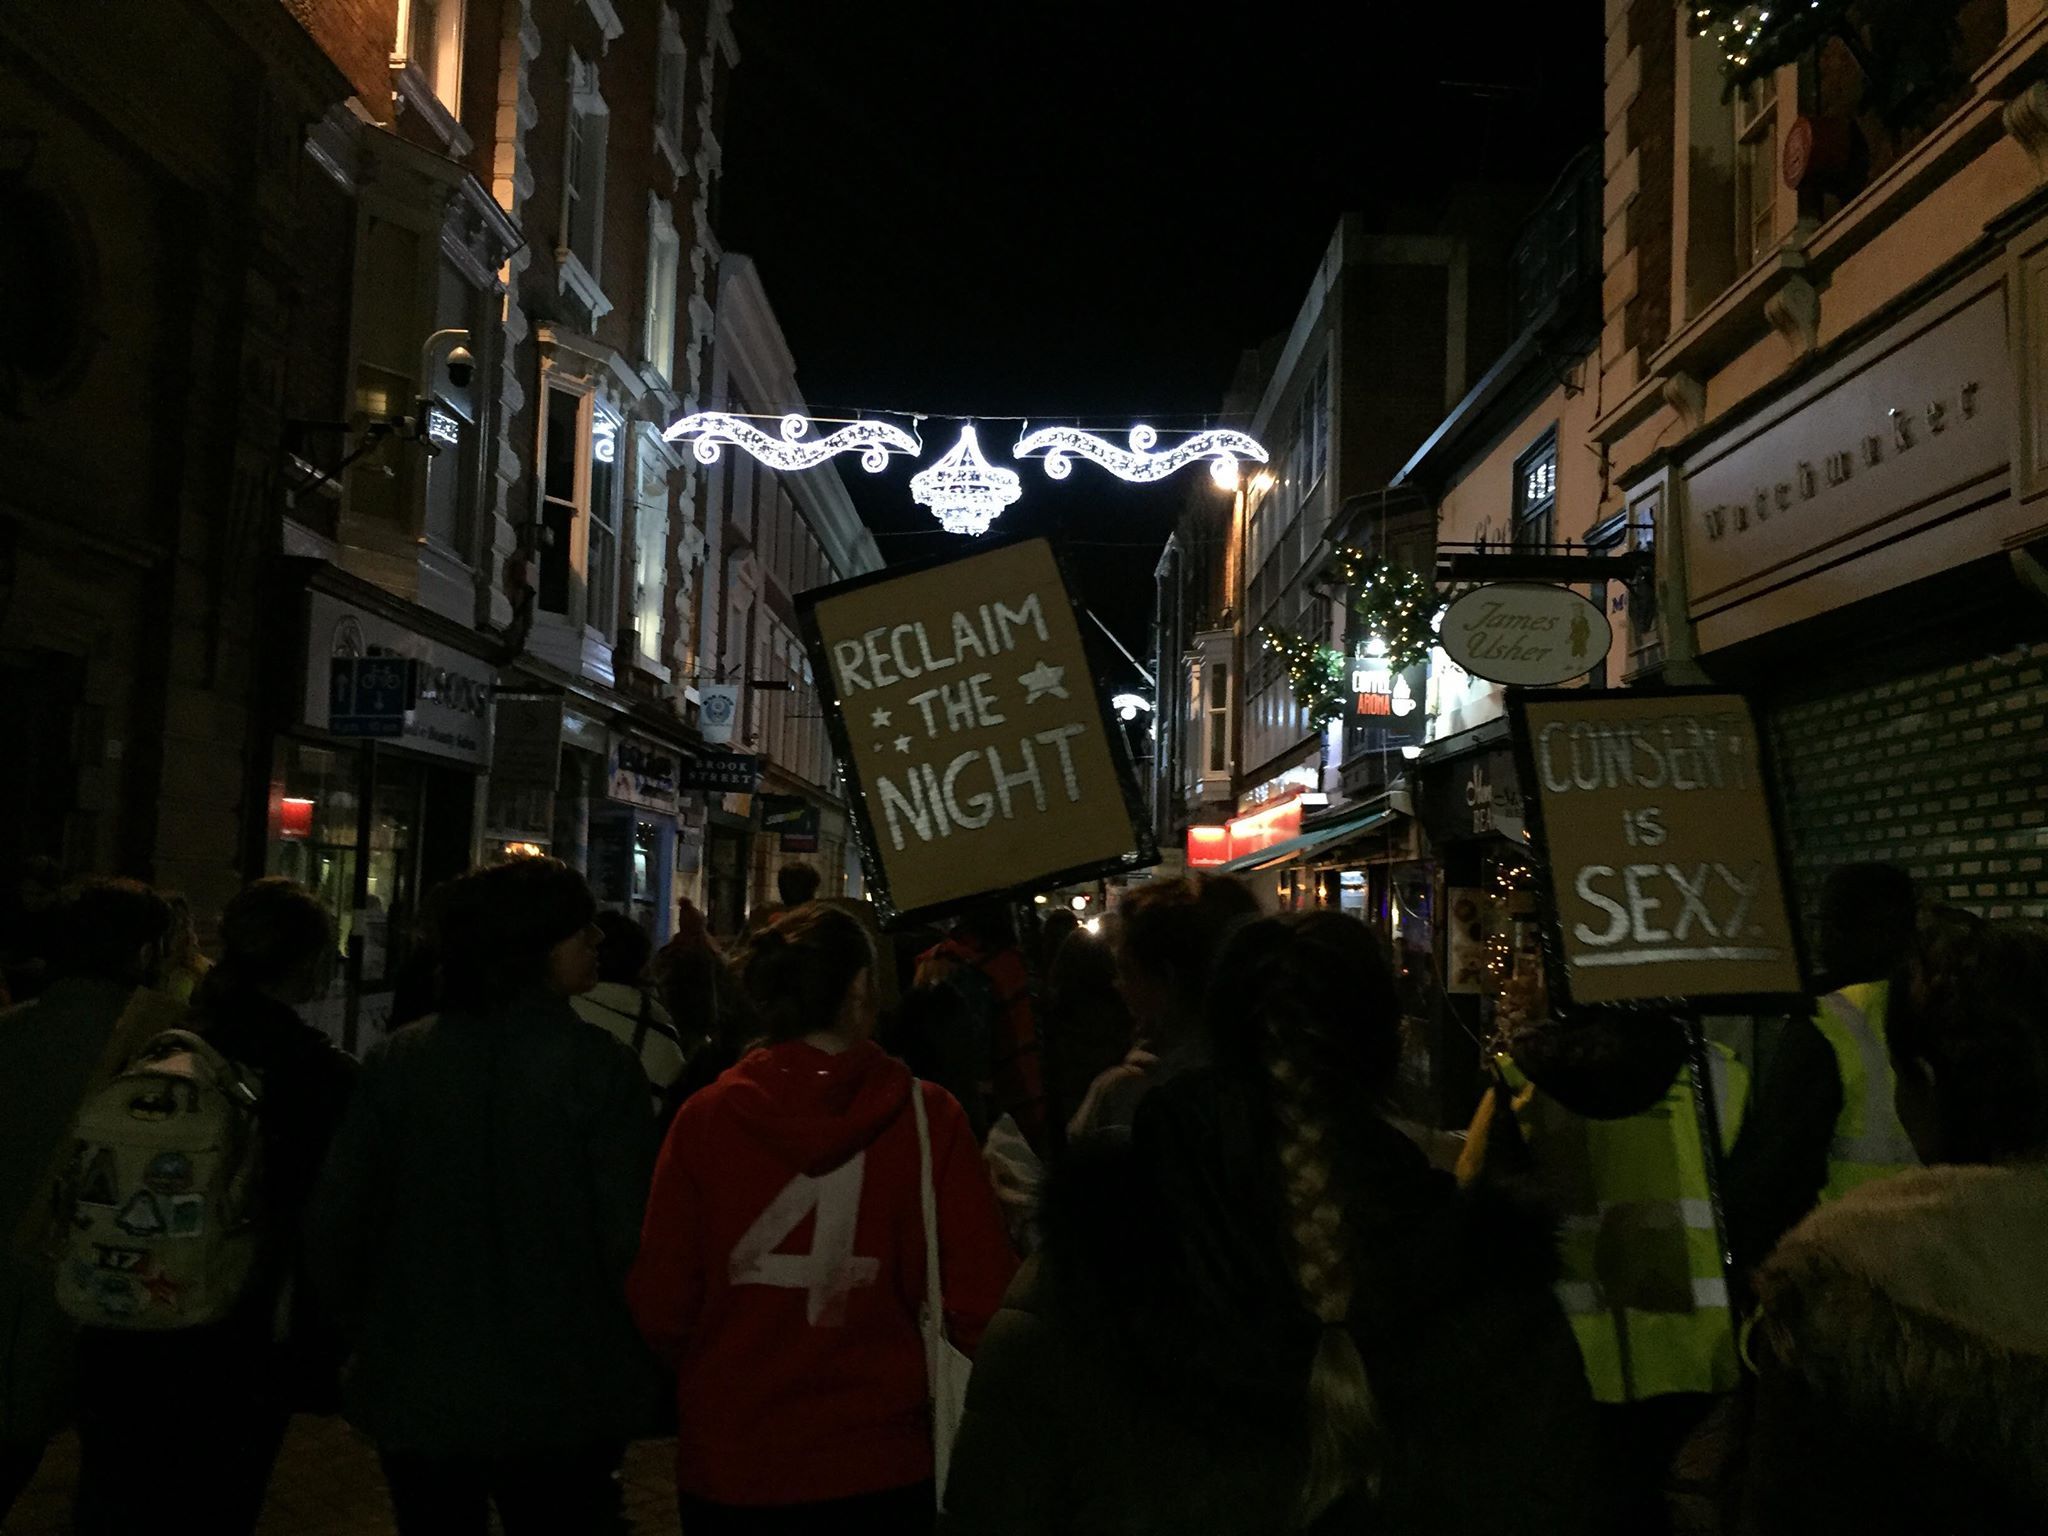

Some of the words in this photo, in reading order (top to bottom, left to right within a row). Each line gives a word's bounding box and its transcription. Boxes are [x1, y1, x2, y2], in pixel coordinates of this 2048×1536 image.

[1463, 602, 1560, 632] James
[833, 592, 1049, 697] RECLAIM
[1466, 630, 1553, 662] Usher
[907, 673, 1007, 739] THE
[1357, 693, 1391, 716] AROMA
[688, 771, 751, 784] STREET
[695, 759, 748, 771] BROOK
[1540, 716, 1749, 793] CONSENT
[876, 722, 1088, 851] NIGHT
[1622, 807, 1667, 847] IS
[1574, 863, 1766, 947] SEXY
[727, 1149, 881, 1328] 4
